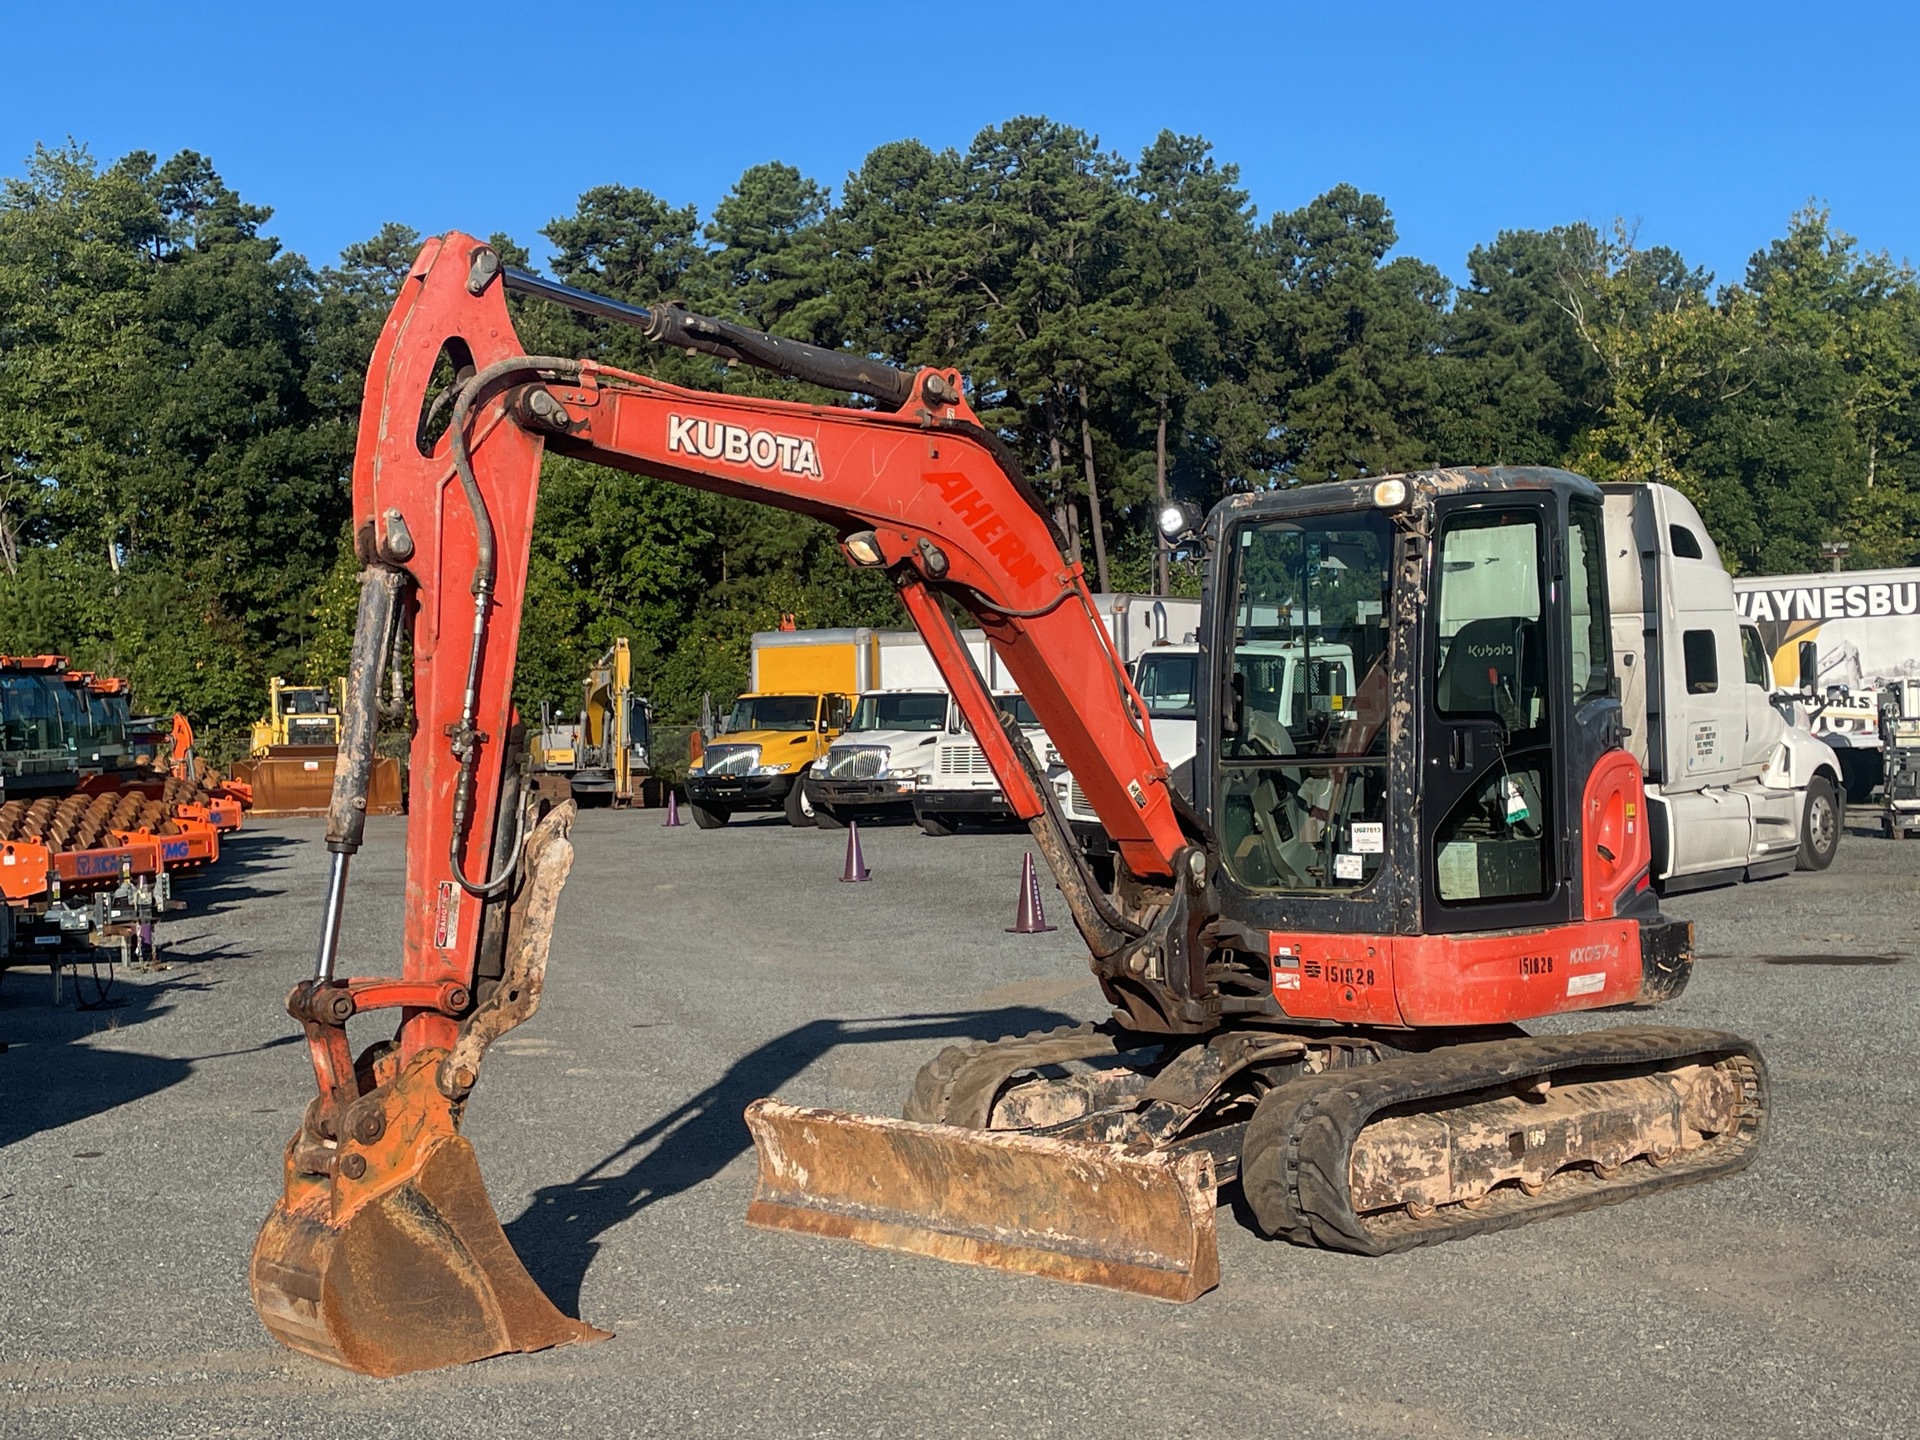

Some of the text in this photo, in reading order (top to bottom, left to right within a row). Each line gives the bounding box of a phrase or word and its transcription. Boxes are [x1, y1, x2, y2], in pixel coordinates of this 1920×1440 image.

[668, 414, 821, 477] KUBOTA
[921, 472, 1048, 590] AHERN
[1467, 643, 1513, 657] Kubota
[1325, 965, 1375, 986] 151828
[1519, 957, 1553, 975] 151828
